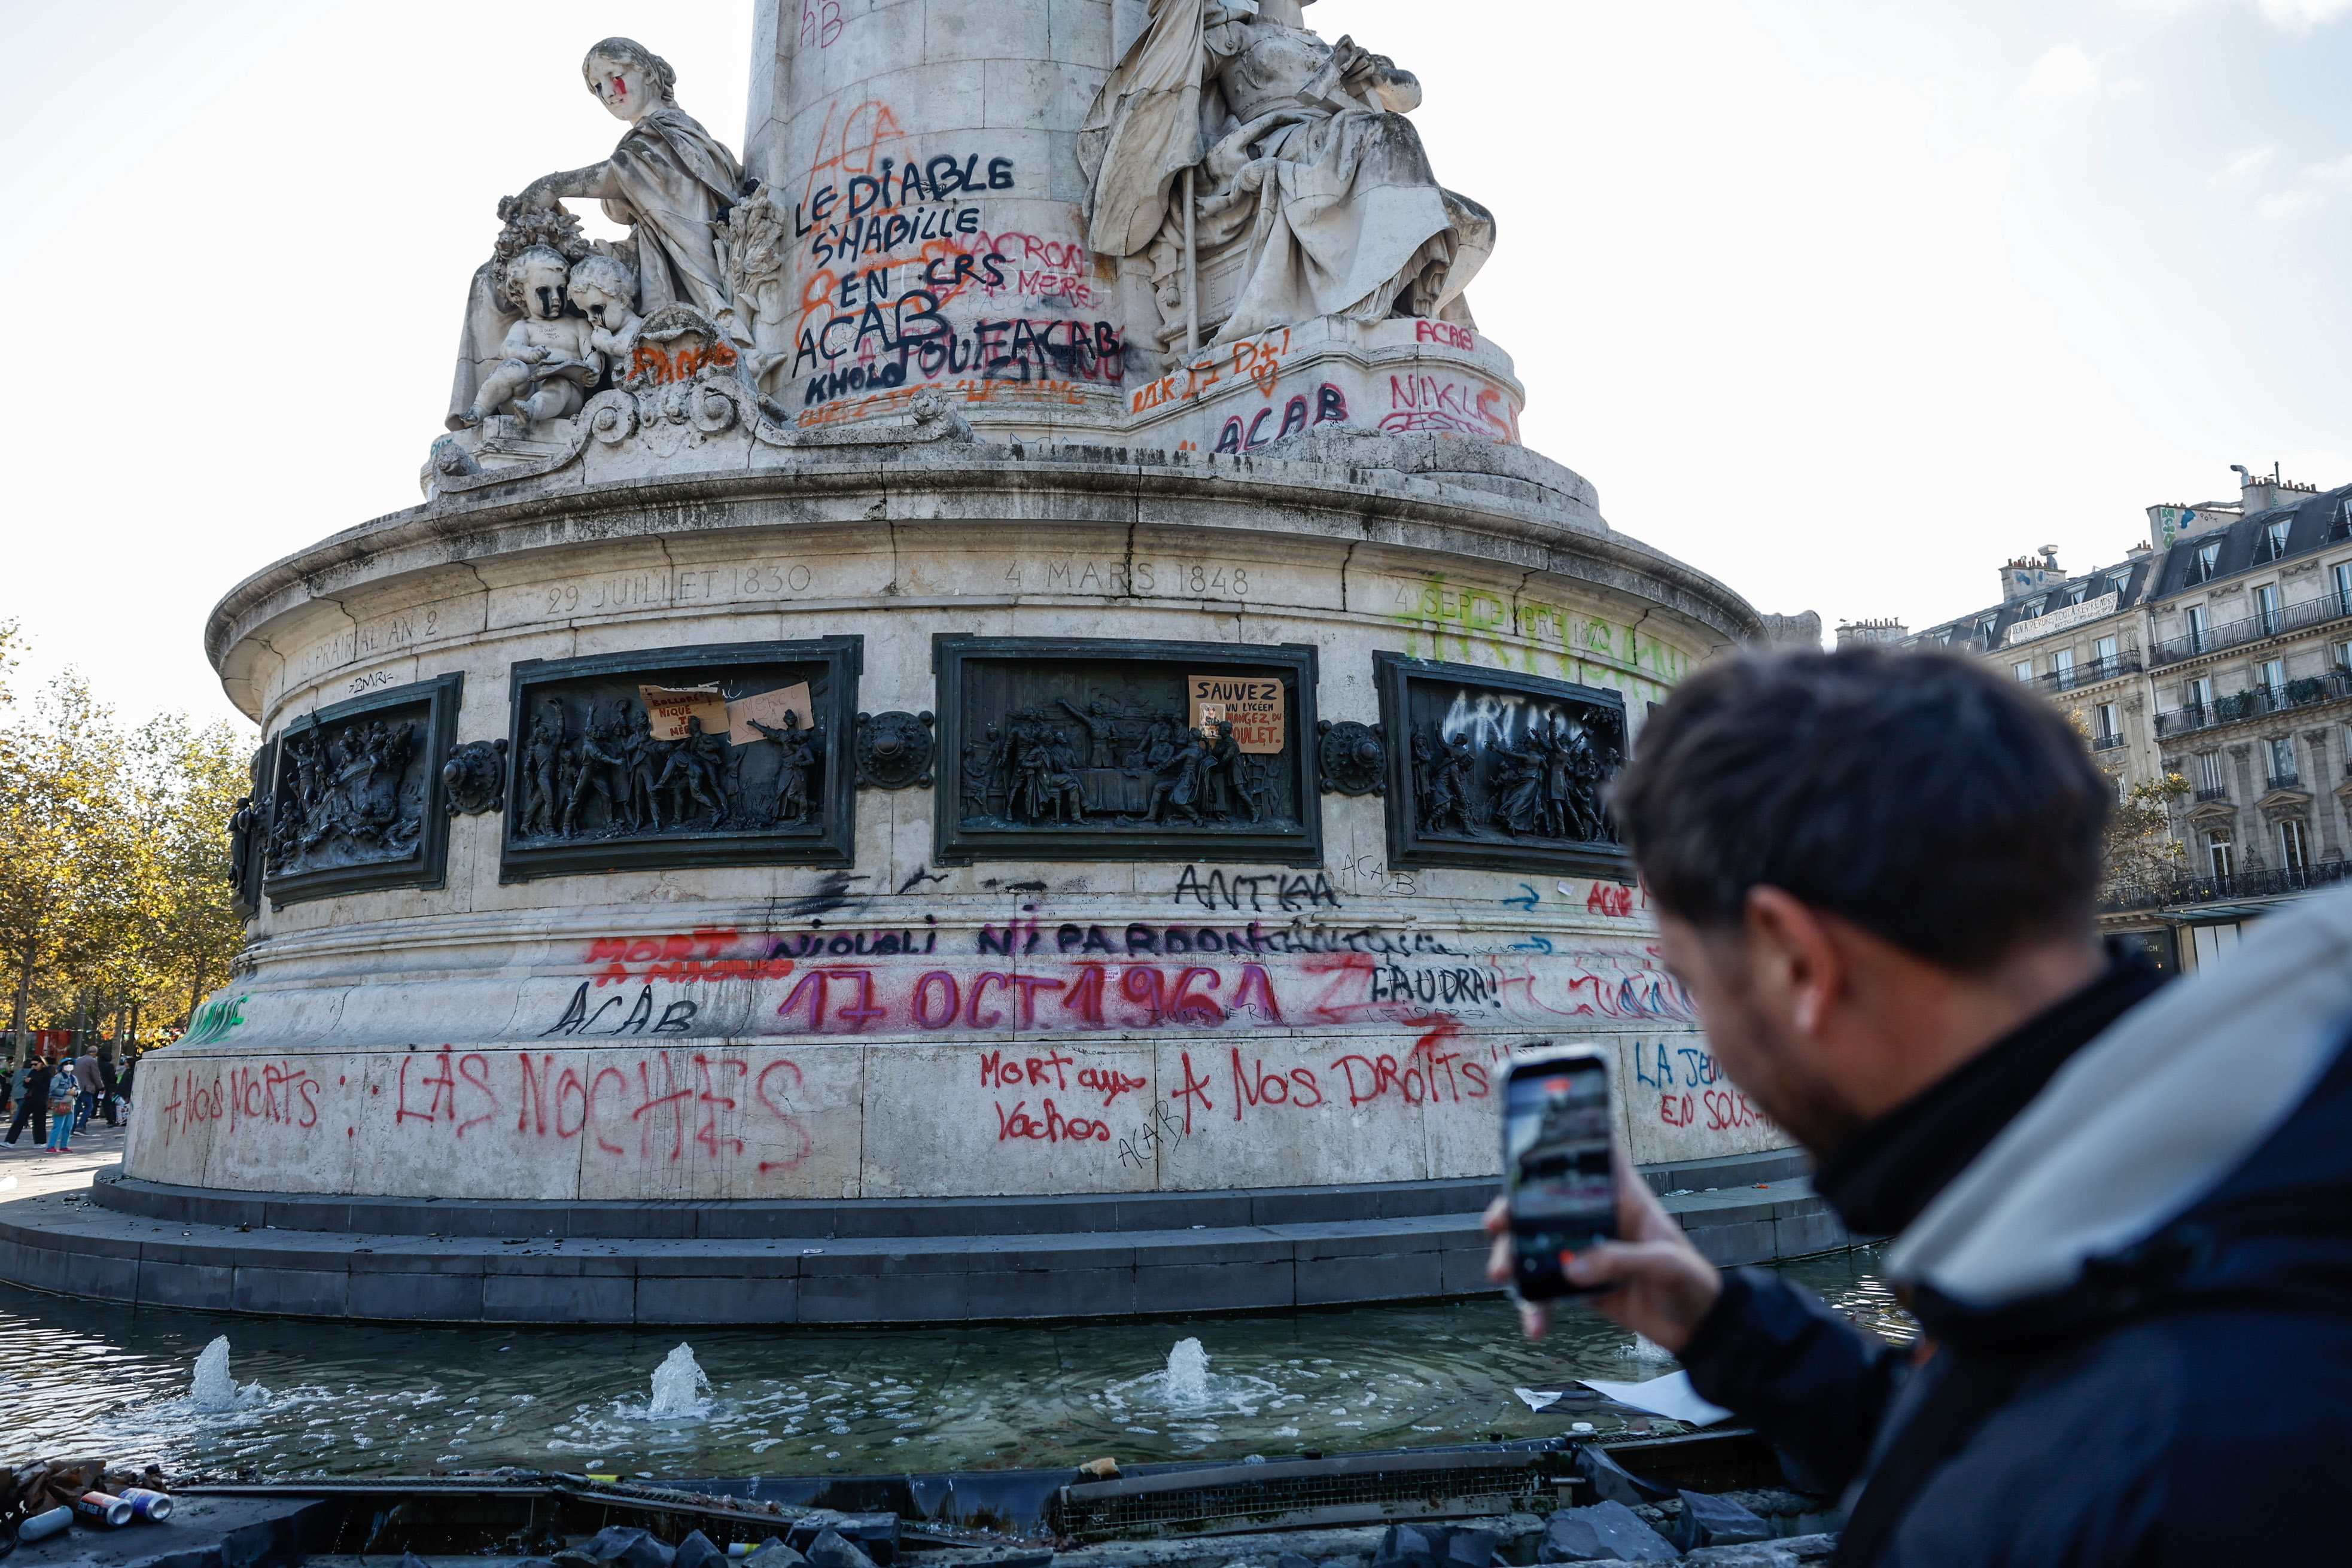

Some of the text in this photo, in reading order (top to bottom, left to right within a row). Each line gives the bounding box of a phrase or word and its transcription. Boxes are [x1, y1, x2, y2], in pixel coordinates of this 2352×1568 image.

[796, 185, 838, 238] LE
[841, 266, 888, 307] EN
[926, 252, 1006, 285] CRS
[792, 289, 949, 378] ACAB
[1213, 383, 1350, 453] ACAB
[1390, 375, 1461, 415] NIK
[546, 565, 811, 615] 29 JUILLET 1830
[1005, 561, 1249, 595] 4 MARS 1848
[388, 615, 413, 645] AN
[426, 610, 437, 636] 2
[1195, 681, 1277, 701] SAUVEZ
[670, 724, 690, 736] MÈR
[1231, 726, 1281, 746] OULET.
[1272, 713, 1282, 721] DU
[538, 981, 698, 1036] ACAB
[777, 969, 889, 1031] 17
[1636, 1041, 1674, 1089] LA
[1172, 1051, 1212, 1138] A
[1661, 1089, 1770, 1131] EN SOUS-
